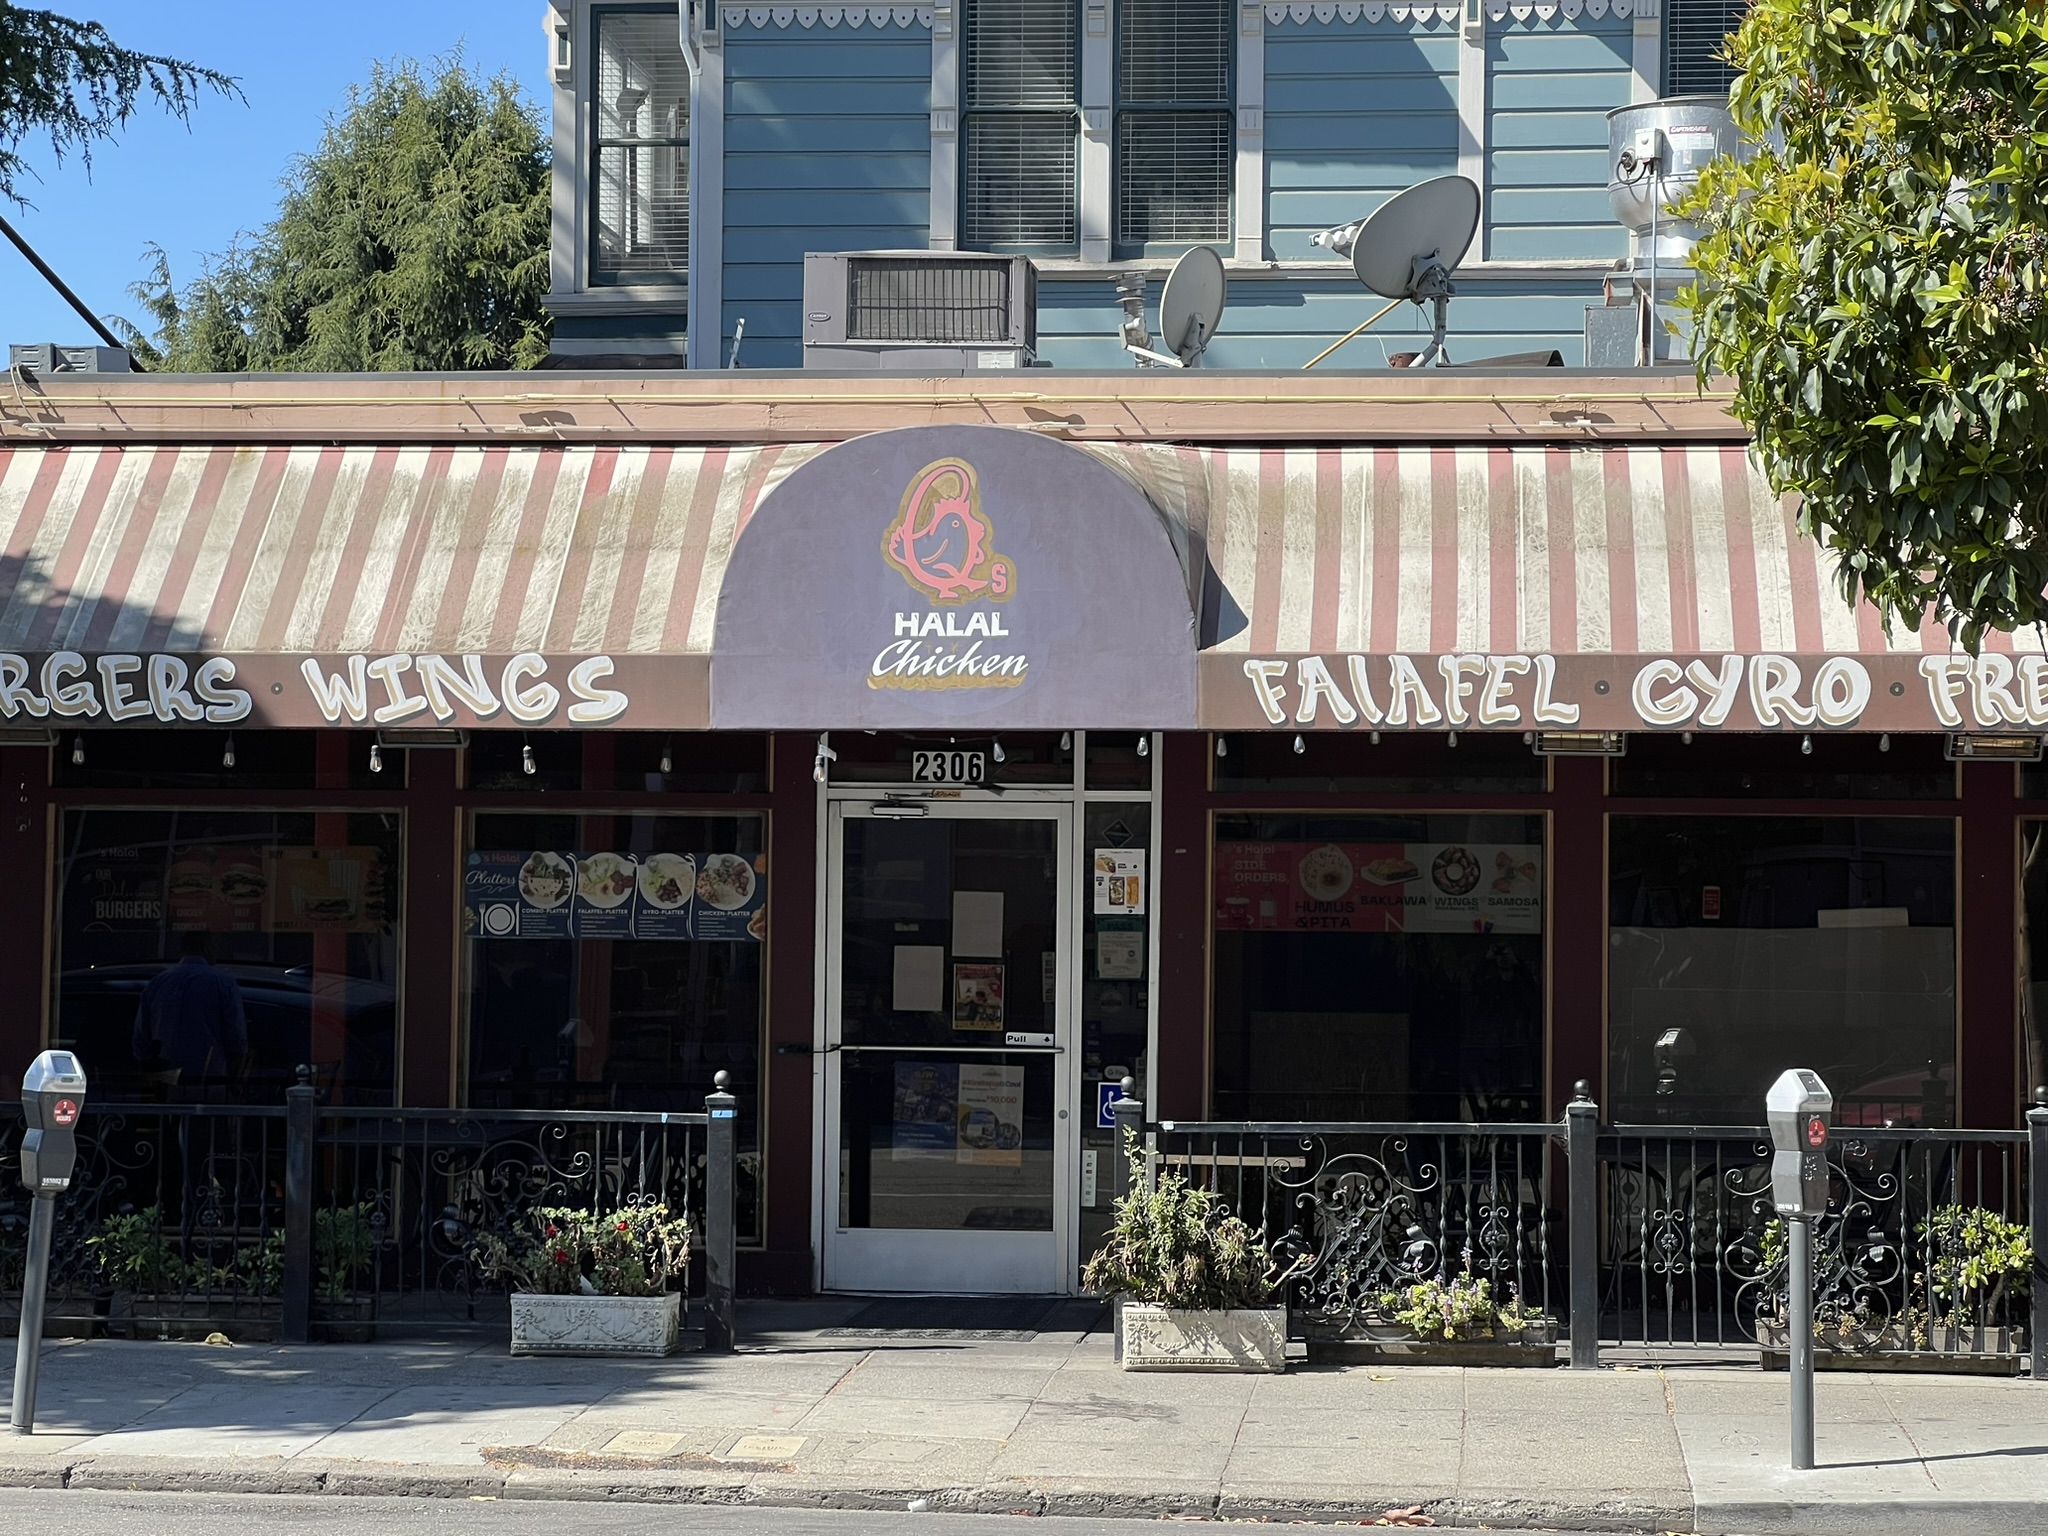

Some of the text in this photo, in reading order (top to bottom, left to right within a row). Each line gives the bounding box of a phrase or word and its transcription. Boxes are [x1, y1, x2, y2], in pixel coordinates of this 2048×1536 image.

[894, 612, 1009, 636] HALAL
[871, 639, 1029, 677] Chicken
[300, 652, 629, 723] WINGS
[1631, 655, 1872, 726] GYRO
[914, 751, 982, 782] 2306
[1234, 860, 1267, 871] SIDE
[465, 870, 517, 886] Platters
[1295, 901, 1355, 913] HUMUS
[1360, 895, 1427, 906] BAKLAWA
[1434, 897, 1479, 907] WINGS
[1487, 897, 1540, 907] SAMOSA
[95, 900, 161, 919] BURGERS
[1295, 916, 1352, 929] &PITA
[1007, 1035, 1026, 1043] Pull
